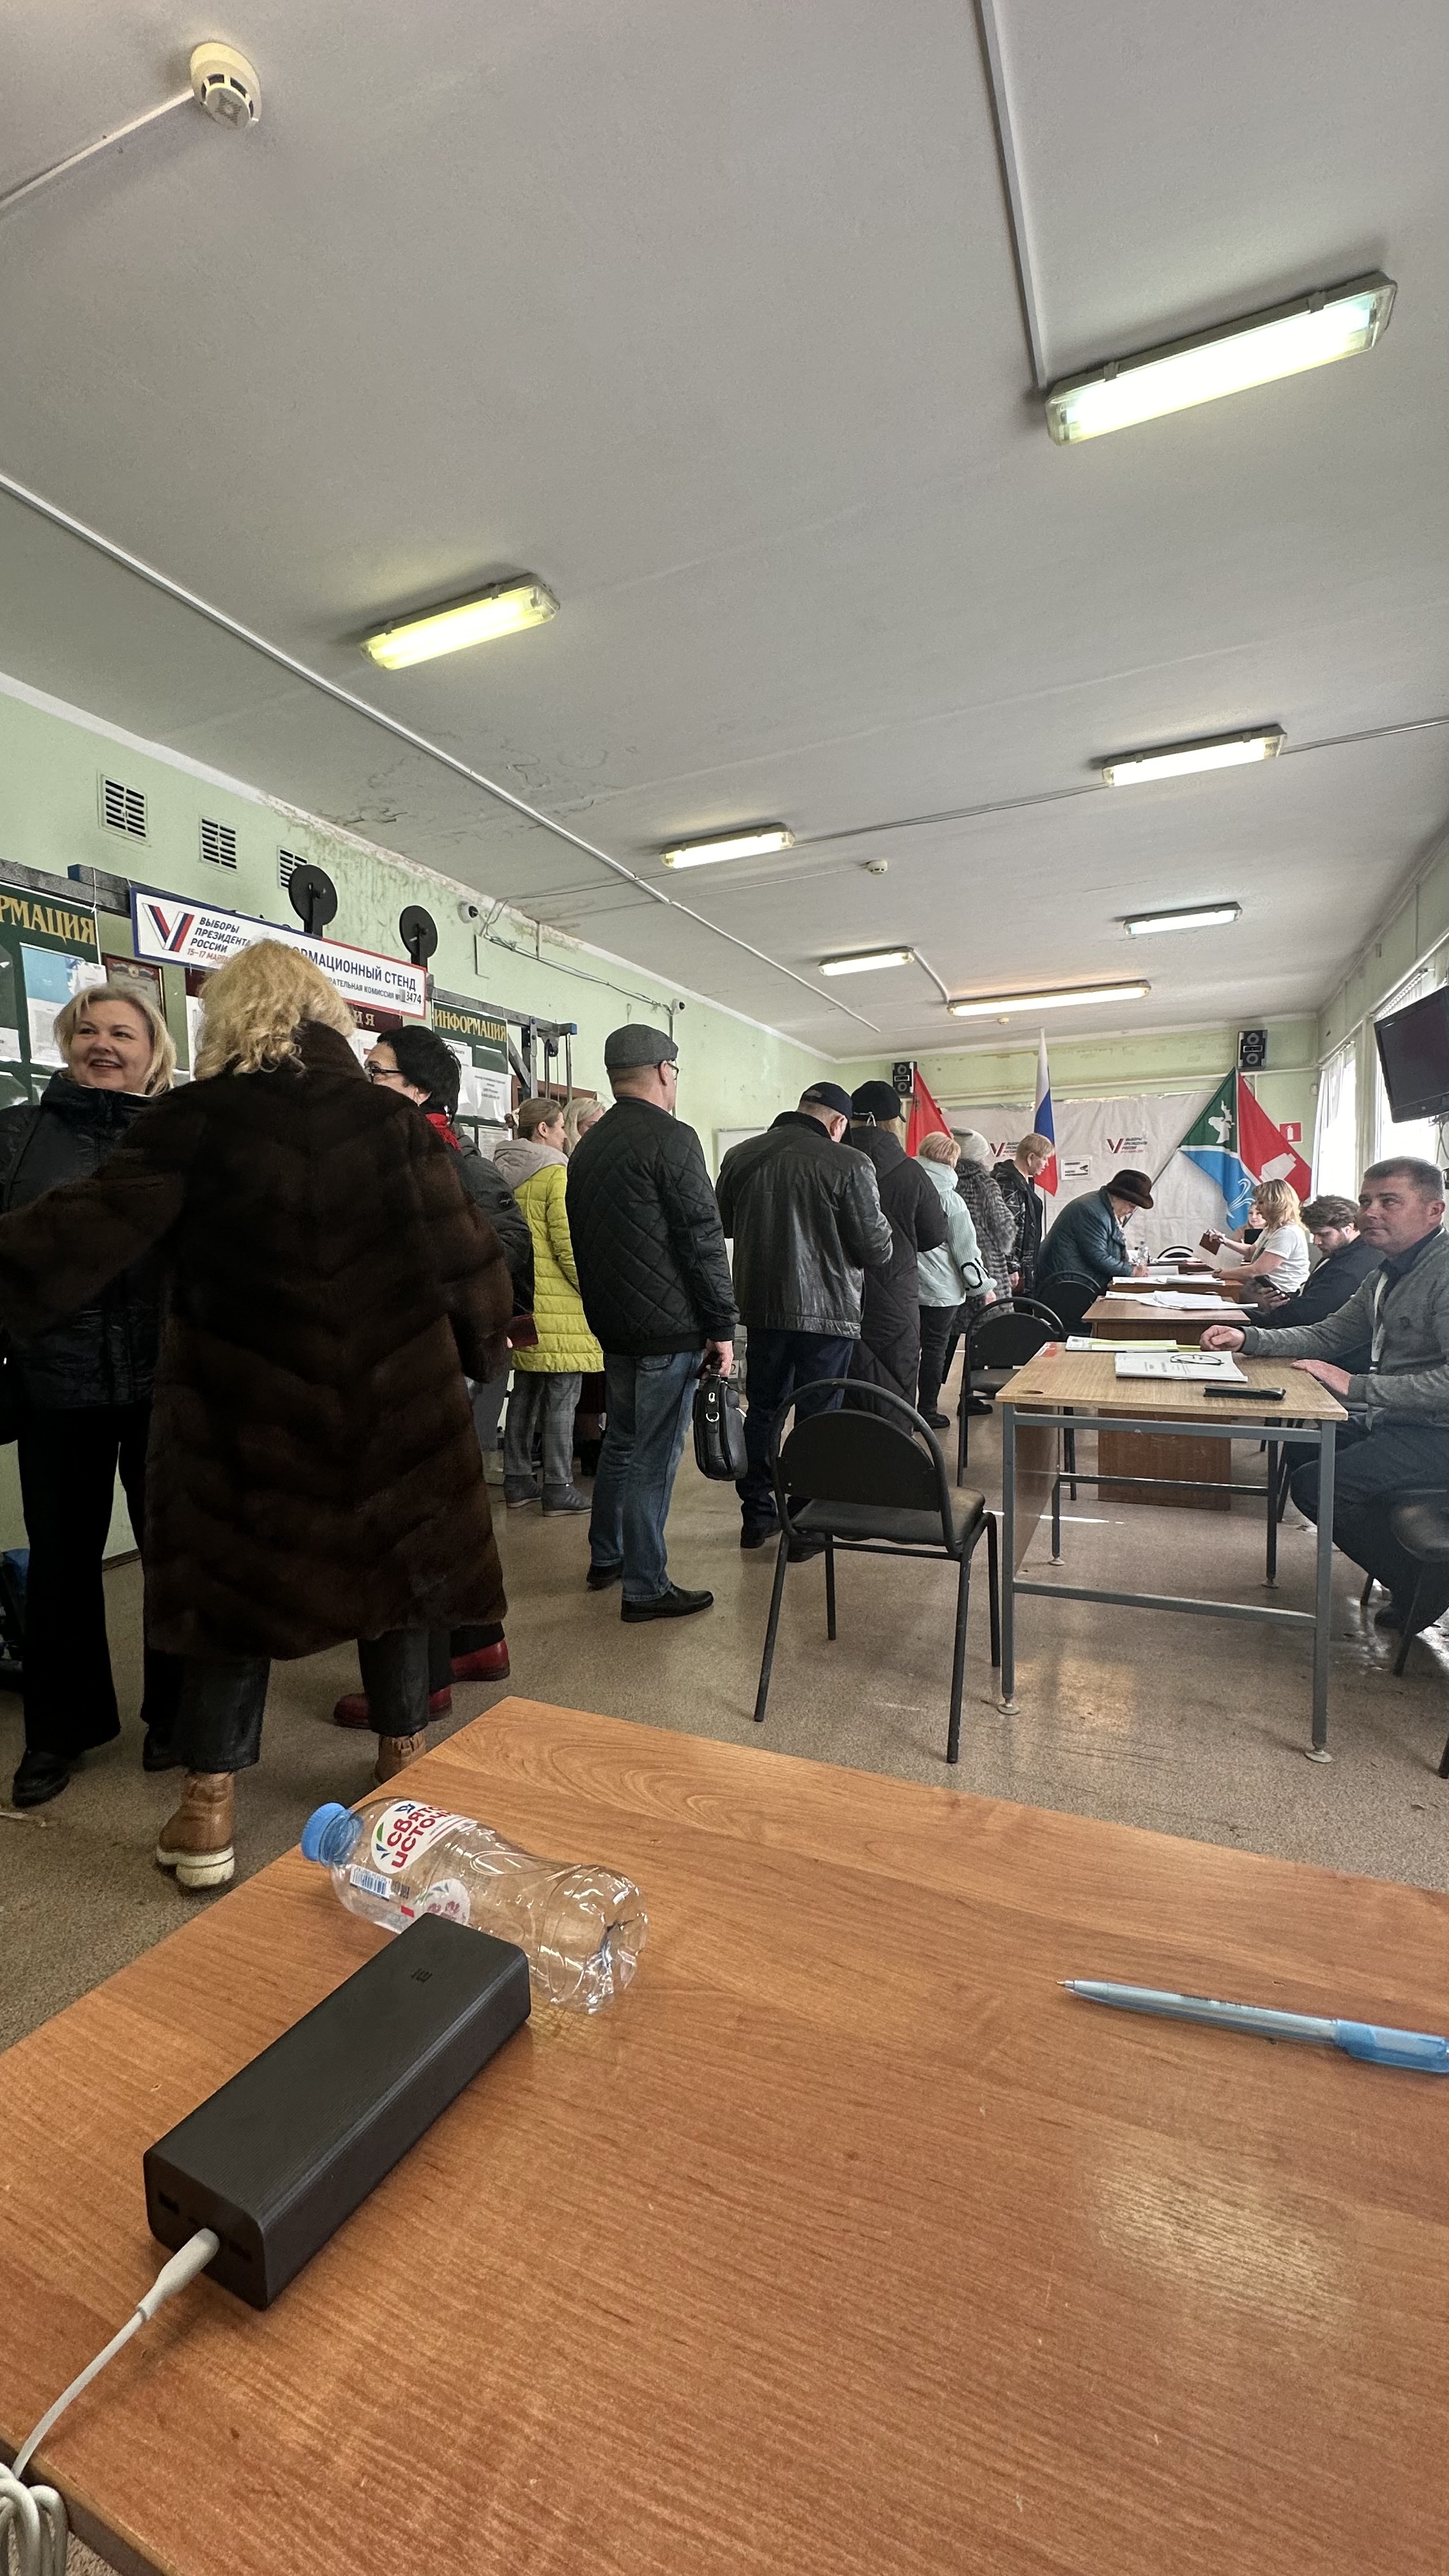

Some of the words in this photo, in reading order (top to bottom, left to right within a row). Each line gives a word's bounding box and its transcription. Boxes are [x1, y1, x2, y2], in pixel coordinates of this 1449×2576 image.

[199, 917, 240, 933] ВЫБОРЫ
[190, 938, 227, 953] РОССИИ
[385, 971, 416, 992] СТЕНД
[364, 986, 394, 999] КОМИССИЯ
[406, 991, 422, 1004] 3474
[434, 1009, 506, 1043] ИНФОРМАЦИЯ
[730, 1363, 737, 1375] 2
